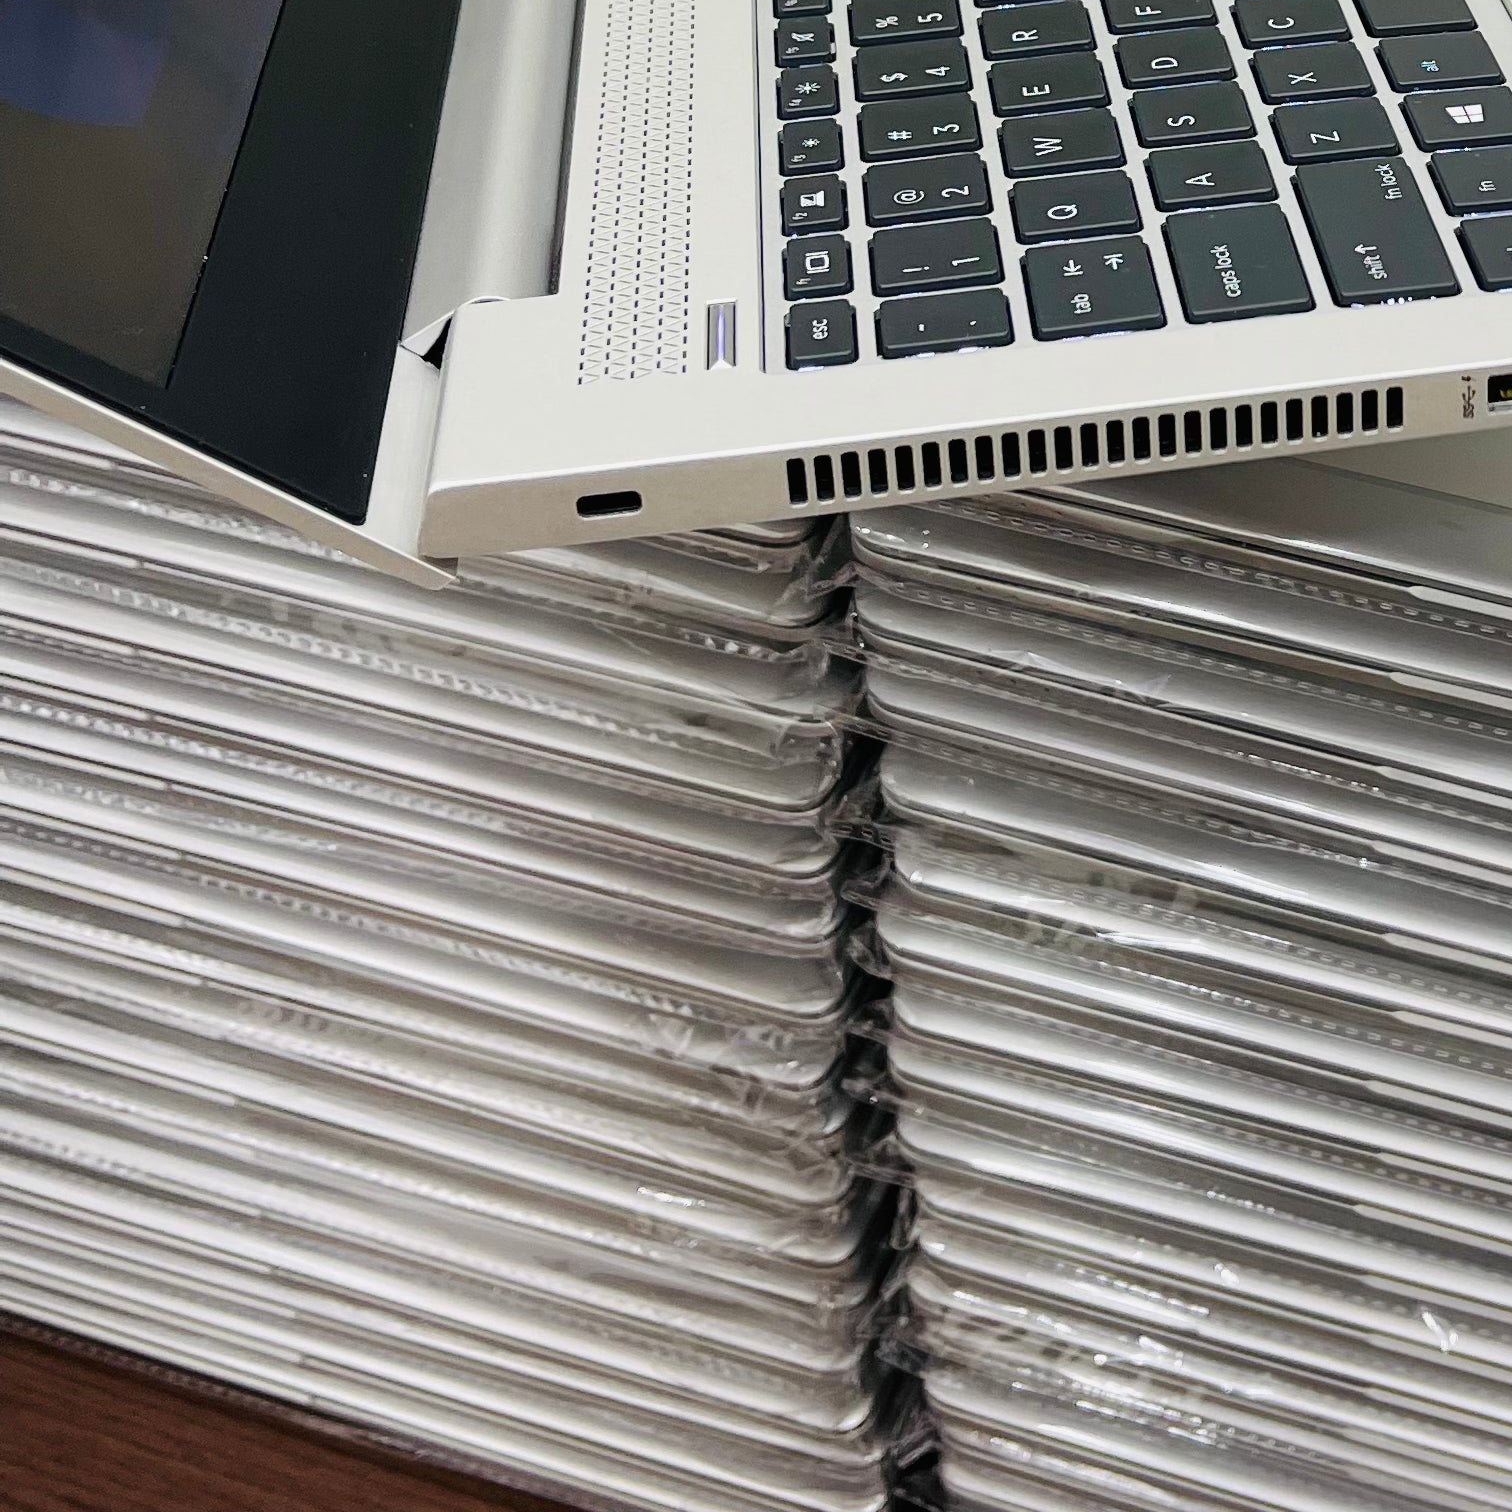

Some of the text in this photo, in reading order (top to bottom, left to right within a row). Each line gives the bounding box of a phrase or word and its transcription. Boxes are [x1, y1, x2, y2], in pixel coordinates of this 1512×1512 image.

[1135, 5, 1162, 16] F
[876, 16, 899, 29] %
[918, 12, 943, 24] 5
[1268, 17, 1294, 29] C
[1012, 29, 1039, 42] R
[1151, 56, 1179, 70] D
[880, 72, 908, 83] $
[925, 66, 950, 76] 4
[1288, 71, 1317, 85] X
[1022, 84, 1051, 97] E
[1167, 115, 1195, 127] S
[887, 130, 912, 141] #
[933, 123, 960, 136] 3
[1310, 130, 1340, 143] Z
[1032, 137, 1063, 156] W
[1185, 172, 1215, 186] A
[1375, 163, 1402, 200] fn lock
[1478, 180, 1496, 191] fn
[893, 189, 925, 204] @
[941, 185, 969, 198] 2
[1047, 204, 1078, 220] Q
[951, 256, 980, 267] 1
[1362, 254, 1388, 279] shift
[1210, 244, 1242, 298] caps lock
[1071, 293, 1092, 315] tab
[812, 318, 828, 340] esc
